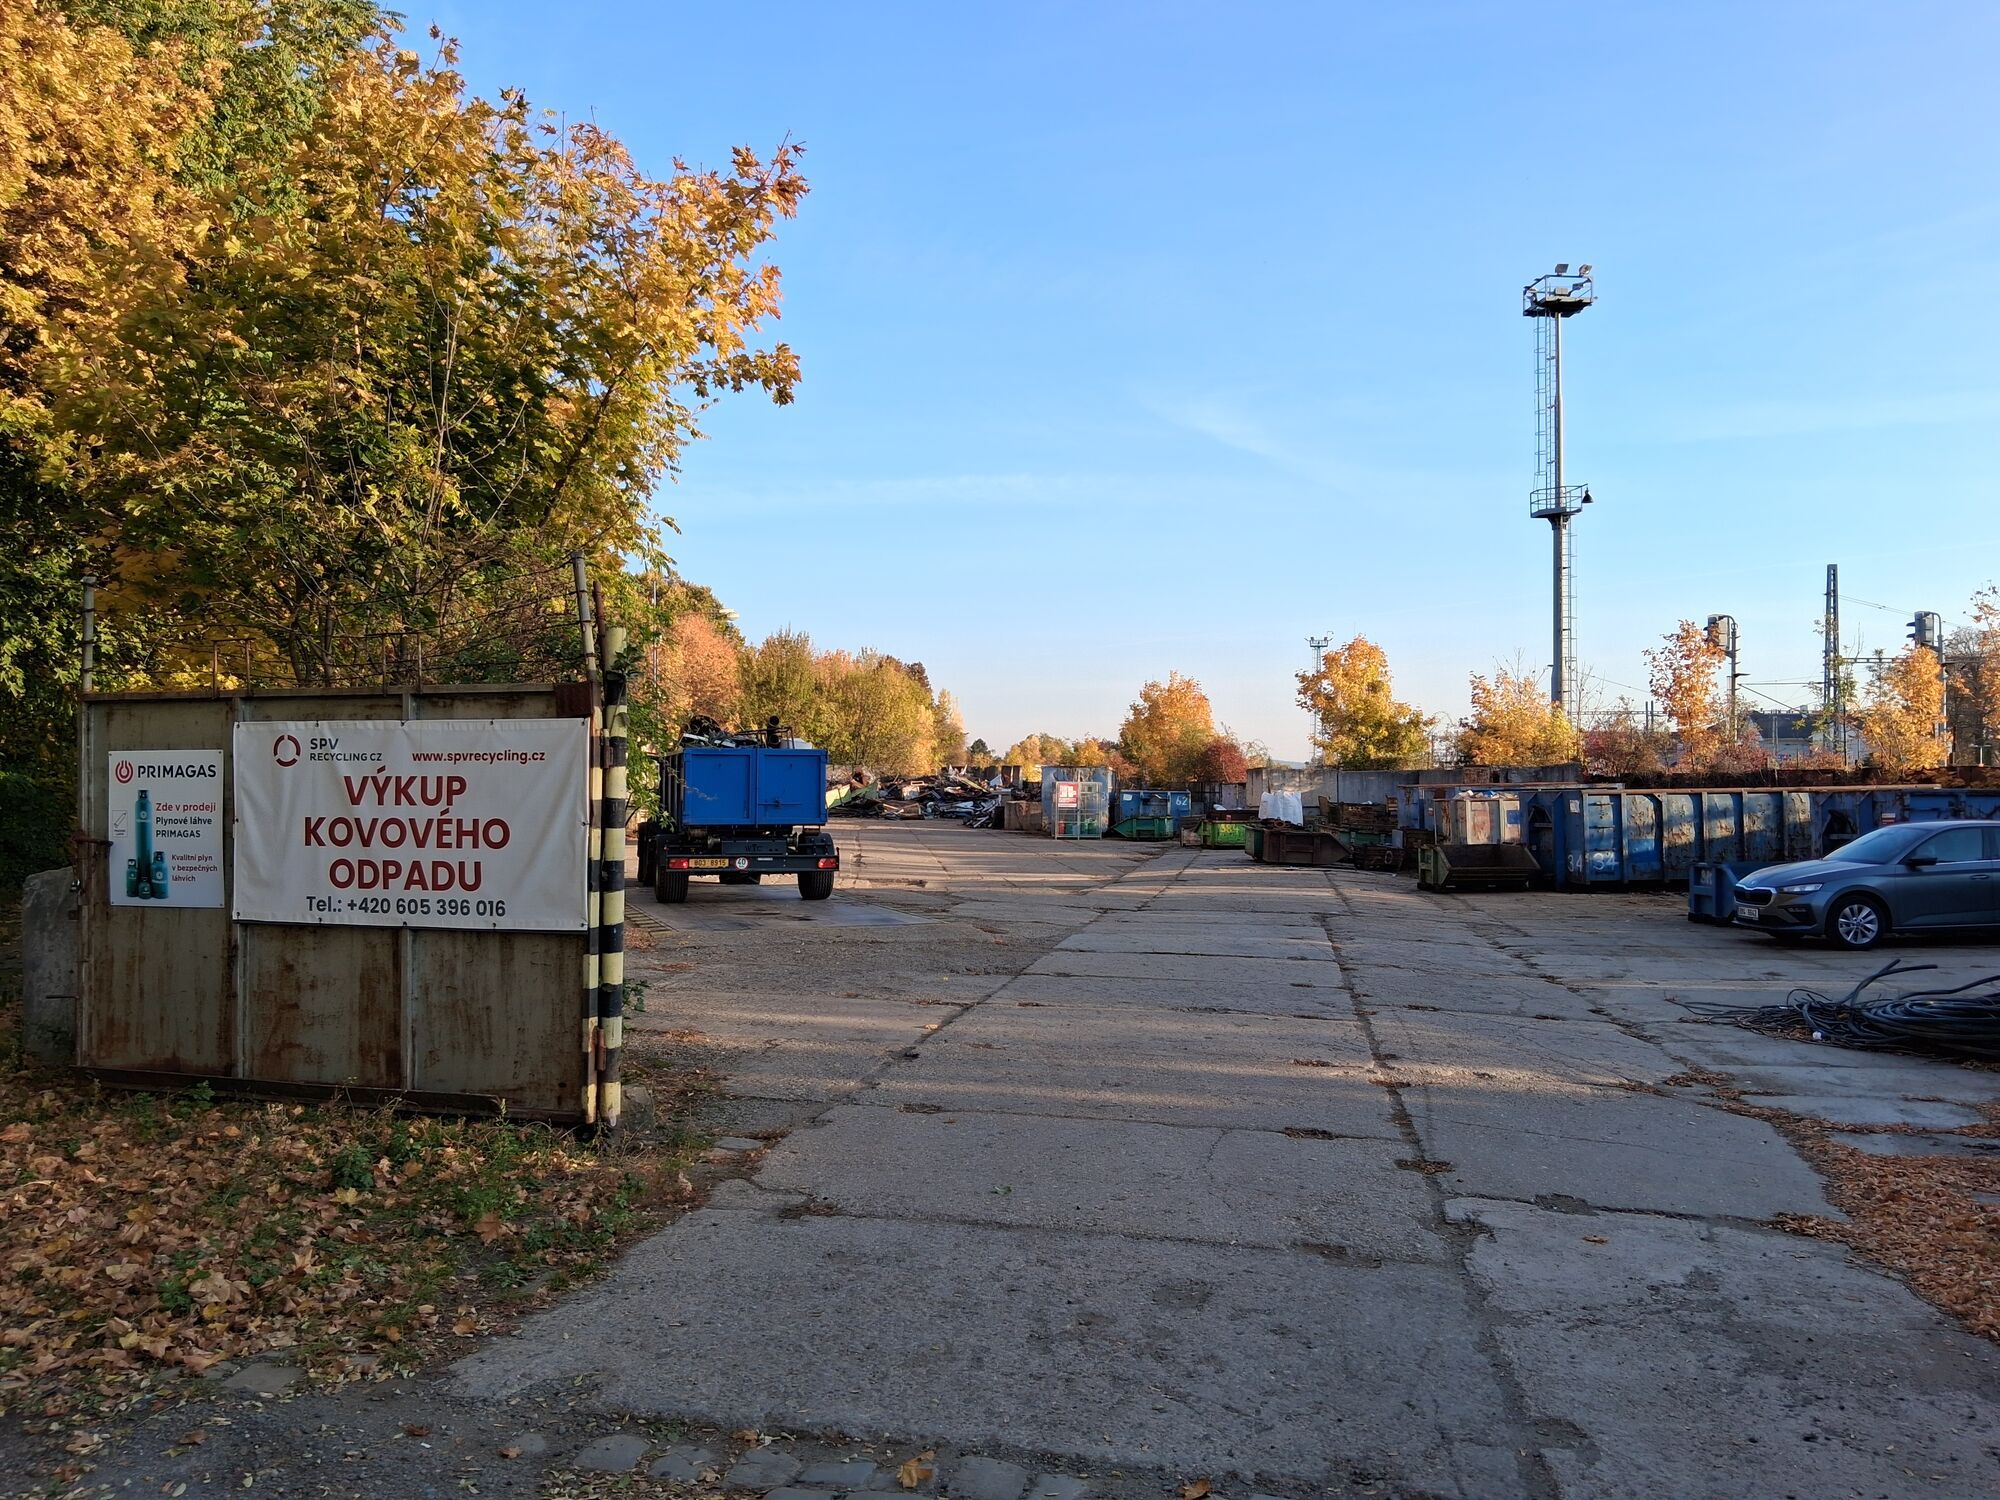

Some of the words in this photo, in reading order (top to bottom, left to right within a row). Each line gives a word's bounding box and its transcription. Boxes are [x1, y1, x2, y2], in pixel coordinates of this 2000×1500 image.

[310, 738, 339, 750] SPV
[309, 752, 368, 761] RECYCLING
[411, 749, 546, 765] www.spvrecycling.cz
[137, 764, 217, 778] PRIMAGAS
[343, 765, 467, 807] VÝKUP
[1175, 795, 1188, 806] 62
[155, 803, 173, 812] Zde
[175, 804, 182, 812] v
[182, 802, 216, 813] prodeji
[155, 816, 188, 826] Plynové
[189, 816, 213, 825] láhve
[155, 829, 201, 838] PRIMAGAS
[304, 807, 511, 850] KOVOVÉHO
[197, 854, 213, 862] plyn
[738, 858, 747, 866] 40
[1567, 854, 1583, 873] 34
[1593, 851, 1619, 871] 34
[328, 858, 483, 892] ODPADU
[305, 895, 342, 913] Tel.:
[347, 897, 391, 914] +420
[396, 897, 431, 915] 605
[436, 898, 471, 916] 396
[476, 899, 506, 917] 016
